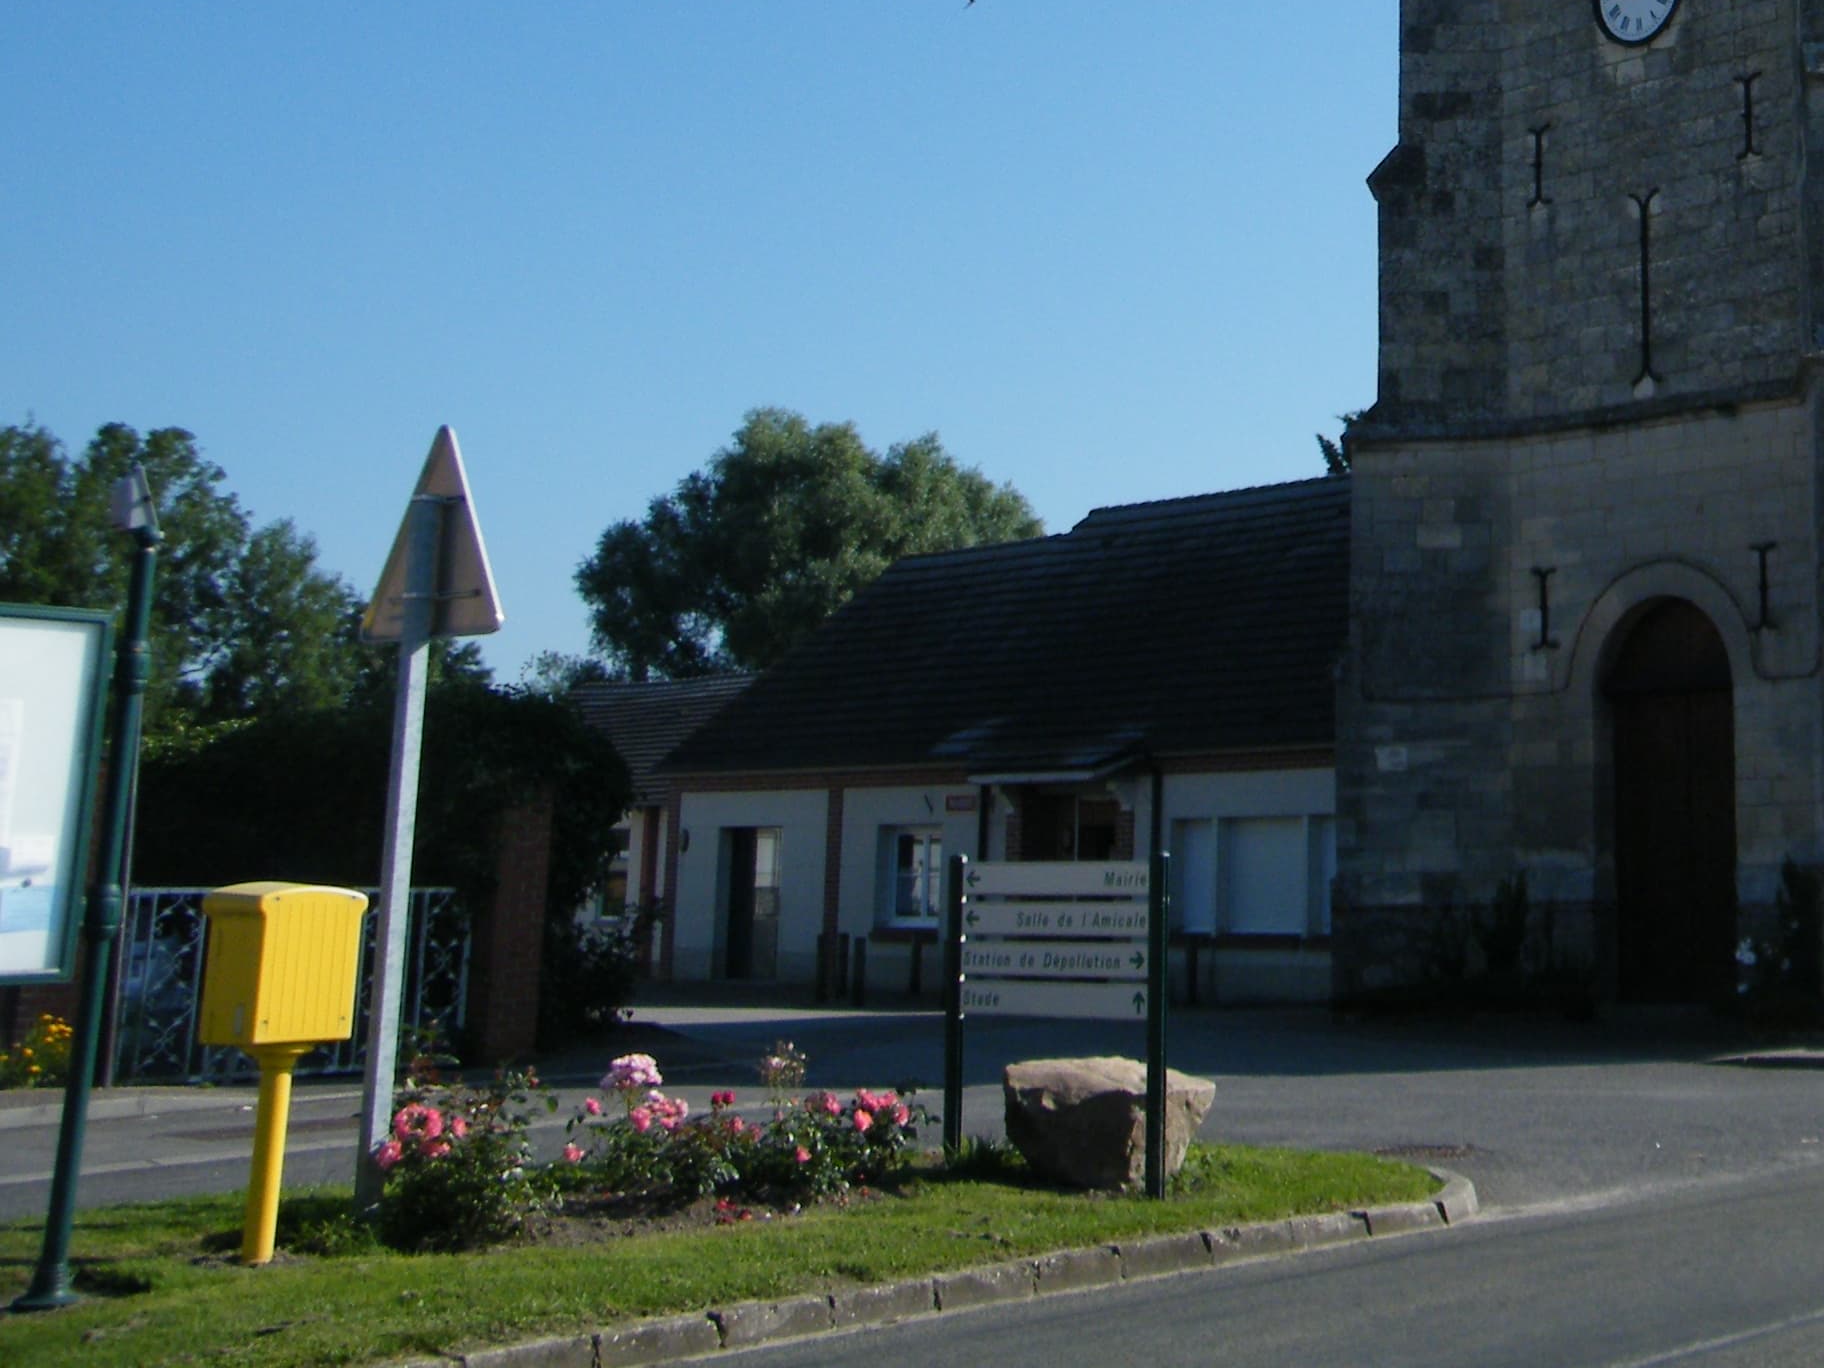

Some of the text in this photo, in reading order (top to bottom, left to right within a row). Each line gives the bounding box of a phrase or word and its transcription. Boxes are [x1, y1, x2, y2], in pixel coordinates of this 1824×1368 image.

[1104, 871, 1147, 887] Mairie
[1017, 912, 1049, 928] Salle
[1057, 913, 1073, 928] de
[963, 951, 1120, 971] Station de Dépollution
[962, 989, 1000, 1006] Stade
